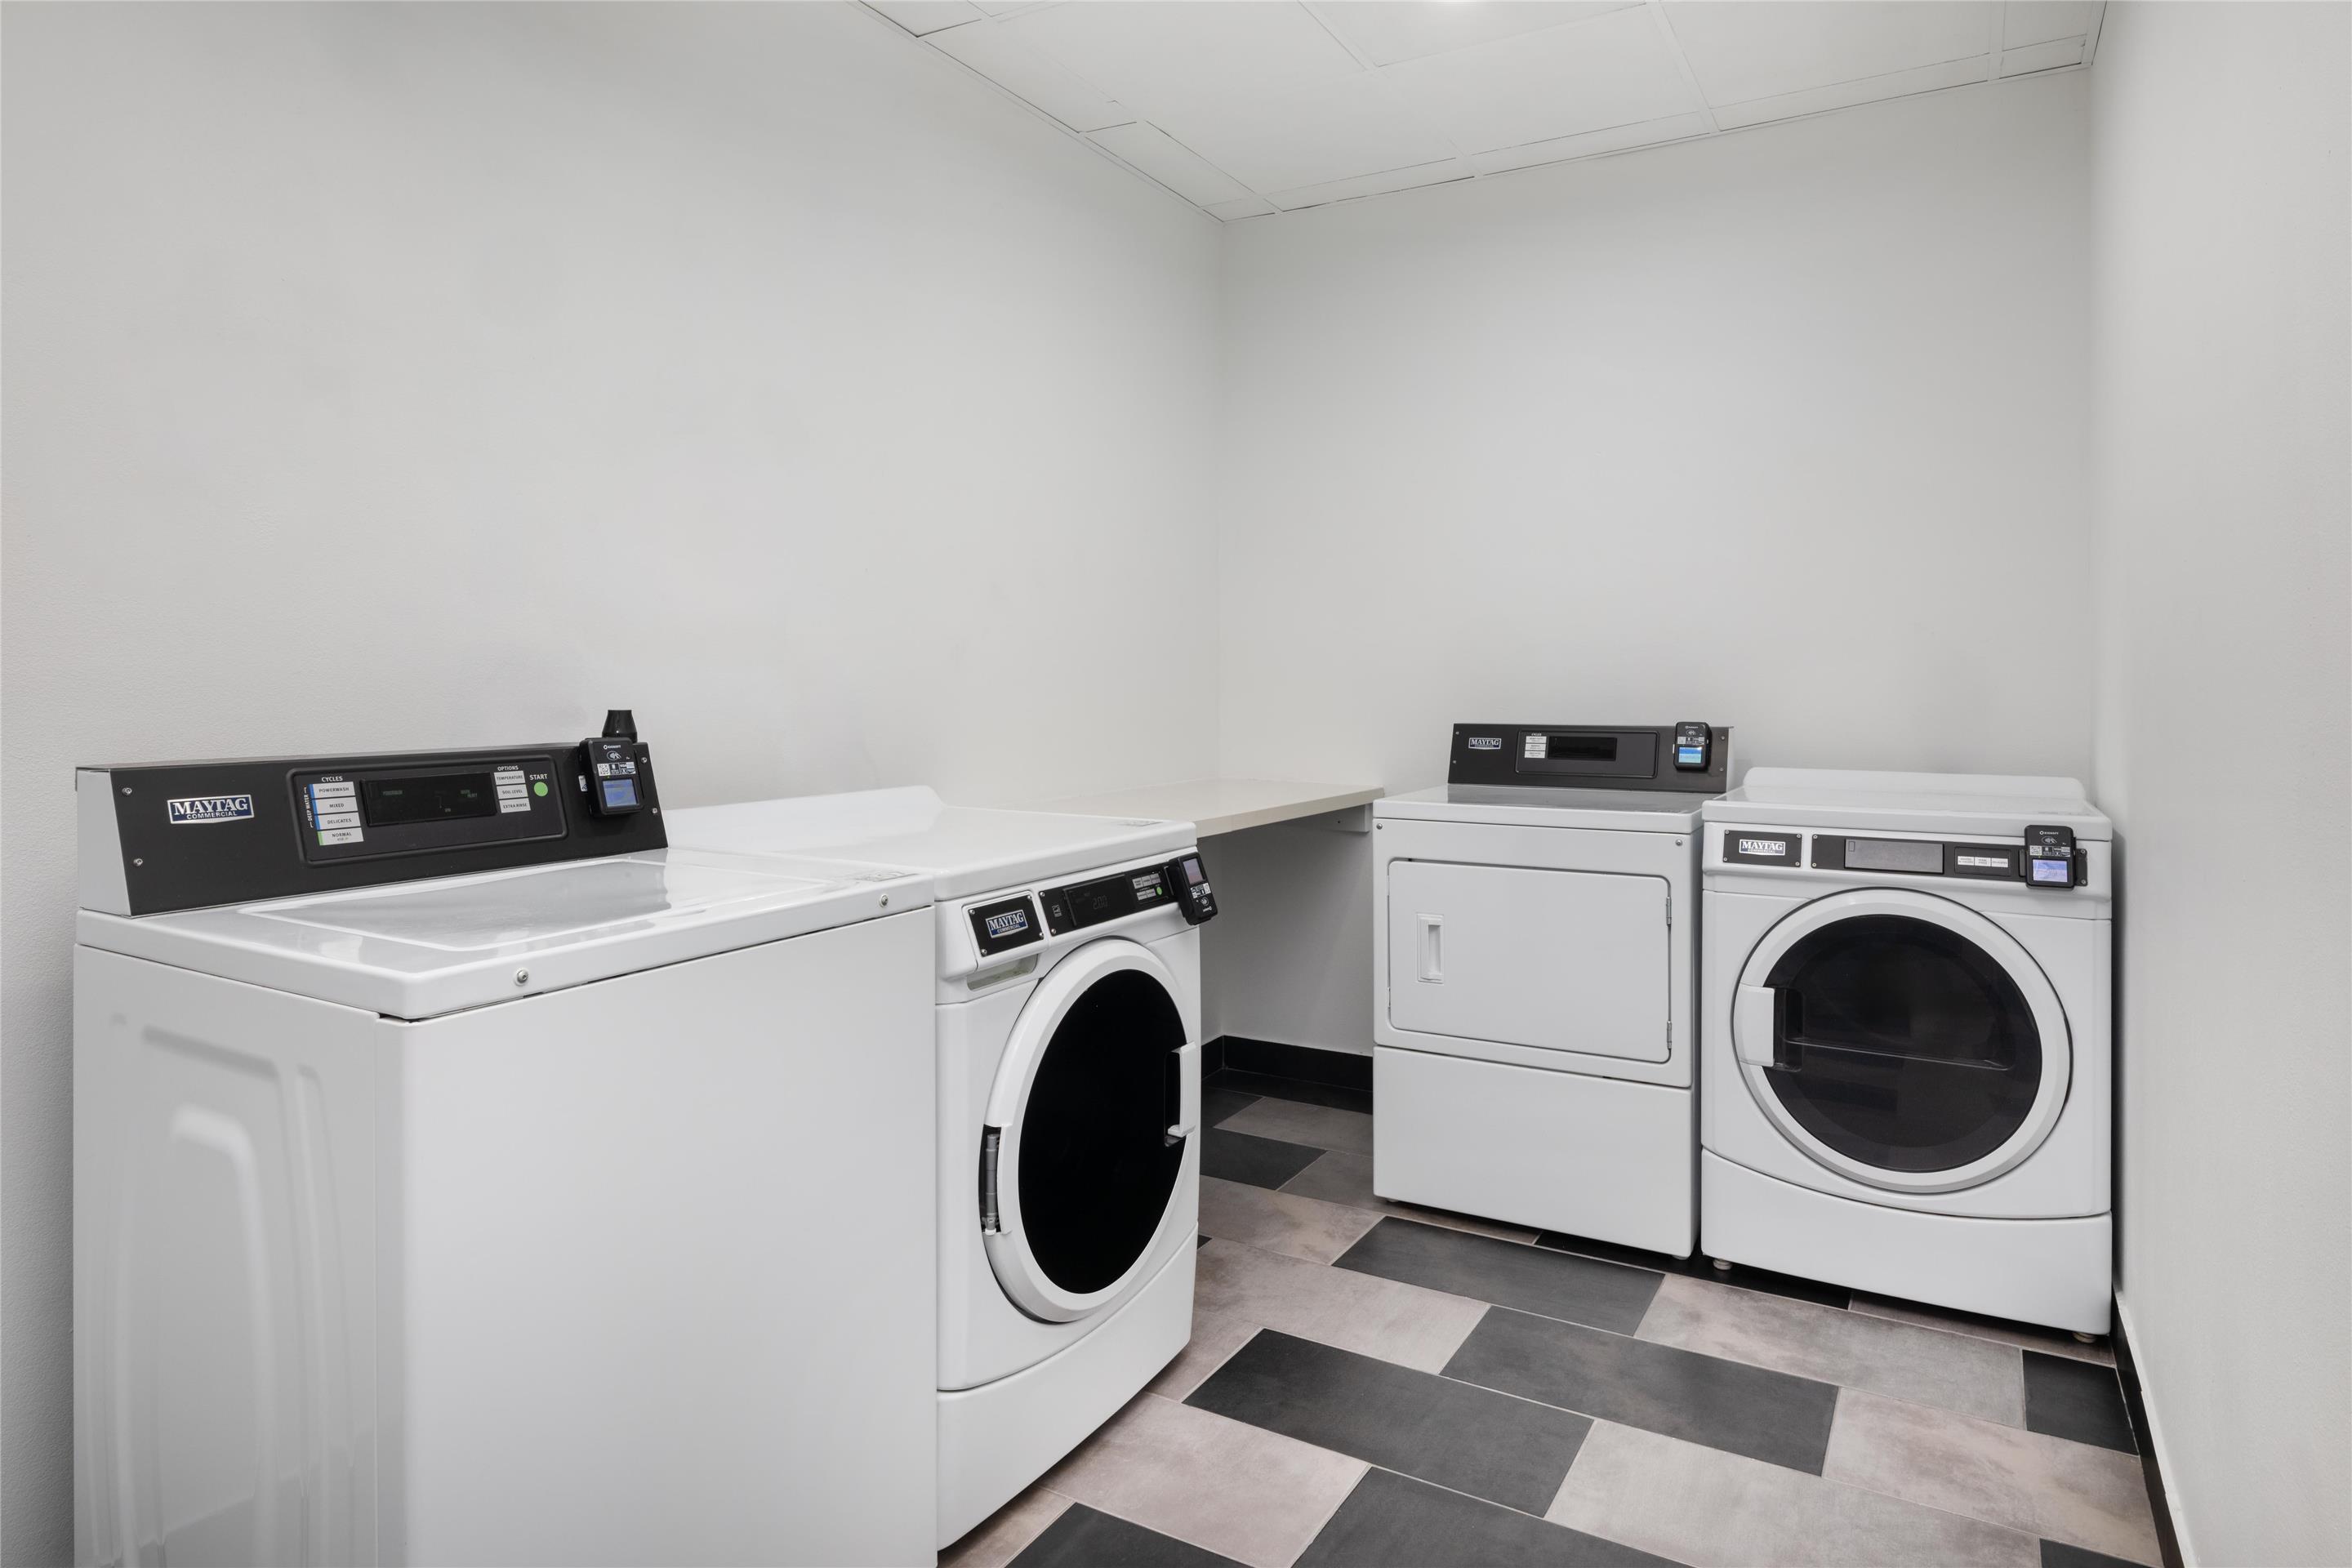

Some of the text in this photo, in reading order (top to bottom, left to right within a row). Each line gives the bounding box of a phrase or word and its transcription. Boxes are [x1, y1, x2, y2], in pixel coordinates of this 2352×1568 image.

[172, 798, 247, 816] MAYTAG
[186, 811, 238, 820] COMMERCIAL
[1742, 841, 1783, 851] MAYTAG
[988, 912, 1025, 930] MAYTAG
